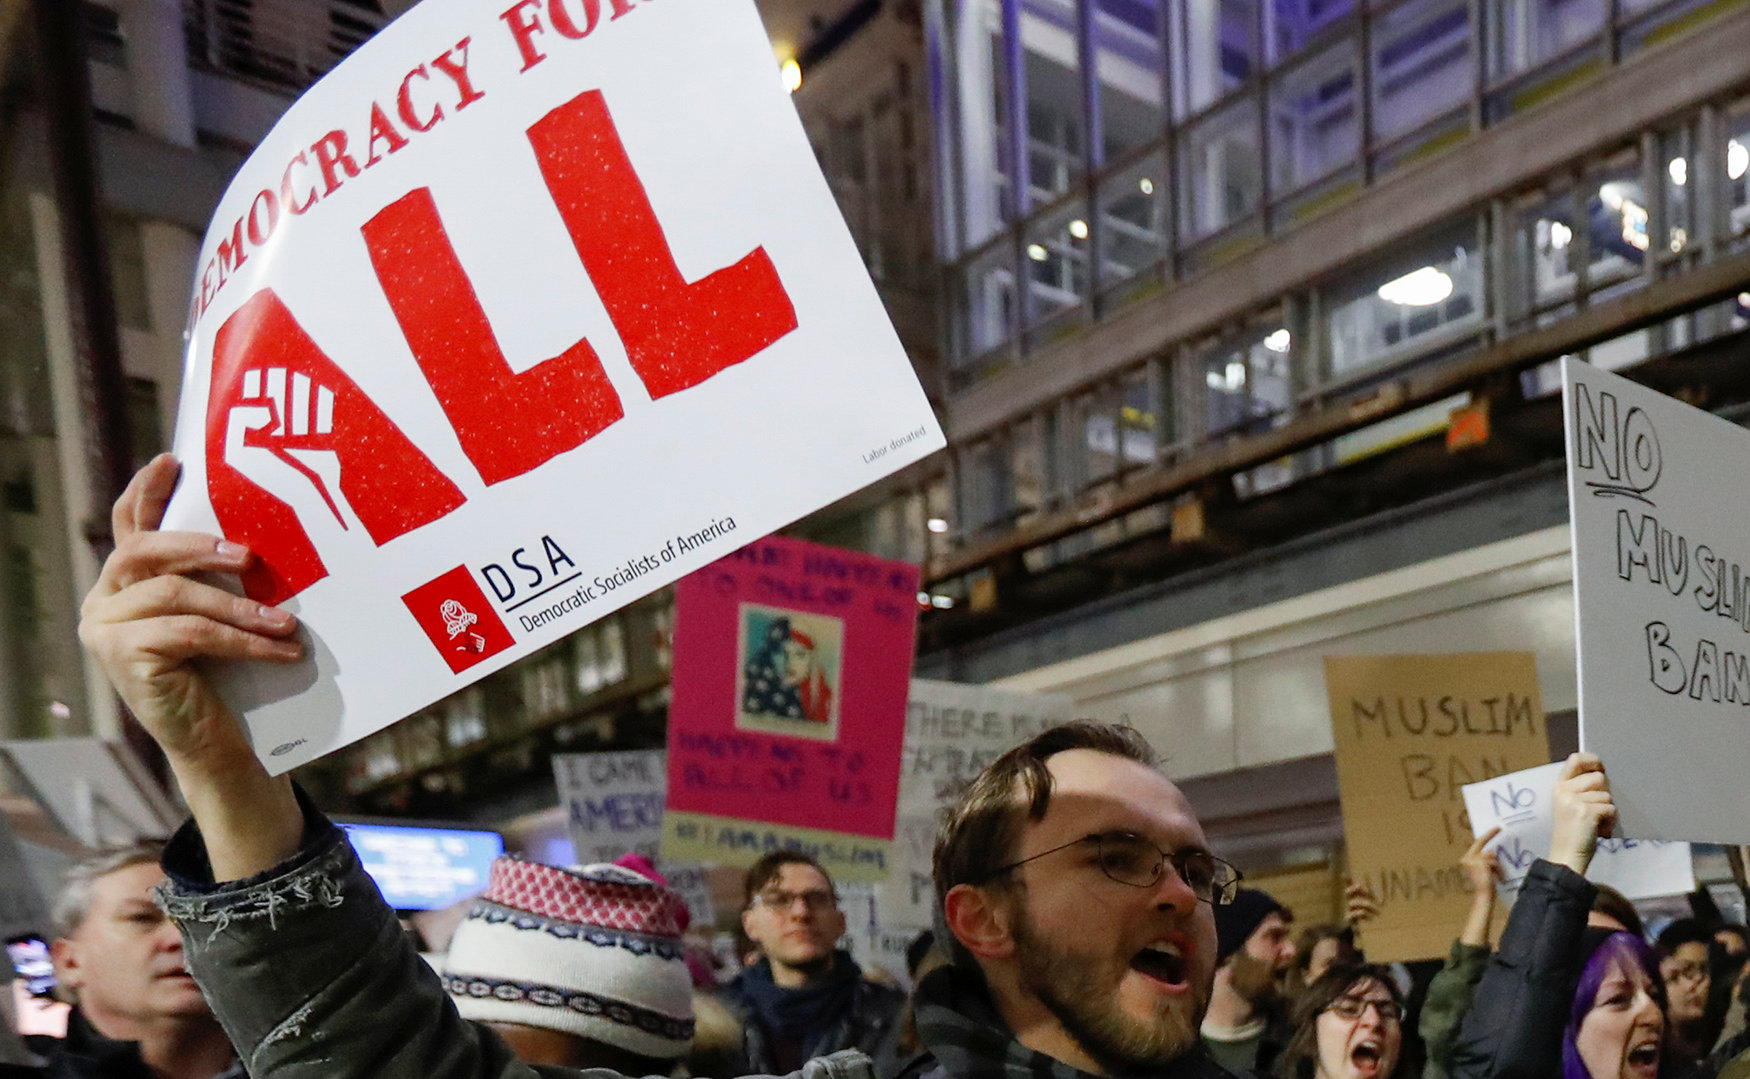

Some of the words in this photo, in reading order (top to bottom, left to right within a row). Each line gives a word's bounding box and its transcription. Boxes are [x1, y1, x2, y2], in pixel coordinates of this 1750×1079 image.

[206, 88, 799, 607] ALL
[862, 446, 888, 464] Labor
[890, 424, 927, 451] donated
[1575, 382, 1662, 494] NO
[480, 534, 576, 603] DSA
[518, 586, 598, 633] Democratic
[594, 554, 661, 596] Socialists
[661, 541, 677, 564] of
[677, 516, 737, 555] America
[1352, 692, 1537, 738] MUSLIM
